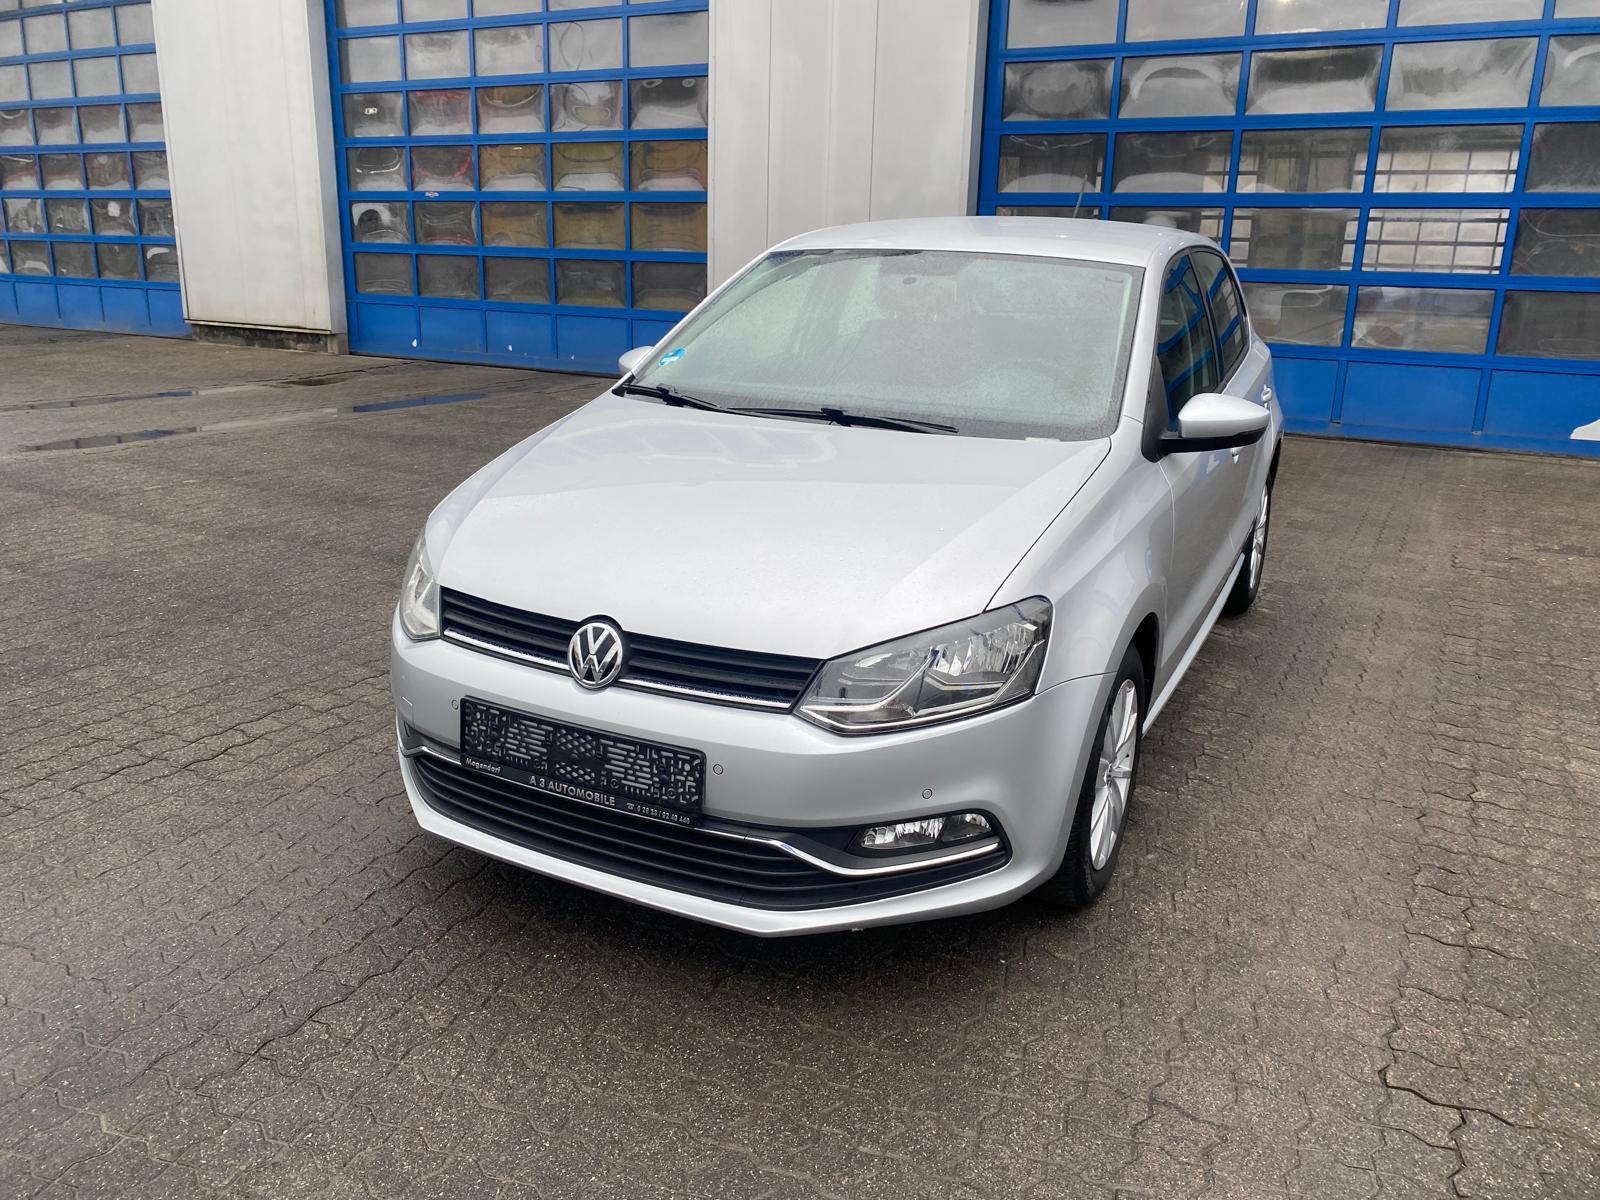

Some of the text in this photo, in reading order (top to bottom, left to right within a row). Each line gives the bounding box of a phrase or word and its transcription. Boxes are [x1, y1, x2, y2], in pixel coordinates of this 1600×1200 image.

[569, 622, 622, 688] VW
[529, 775, 615, 806] A 3 AUTOMOBILE
